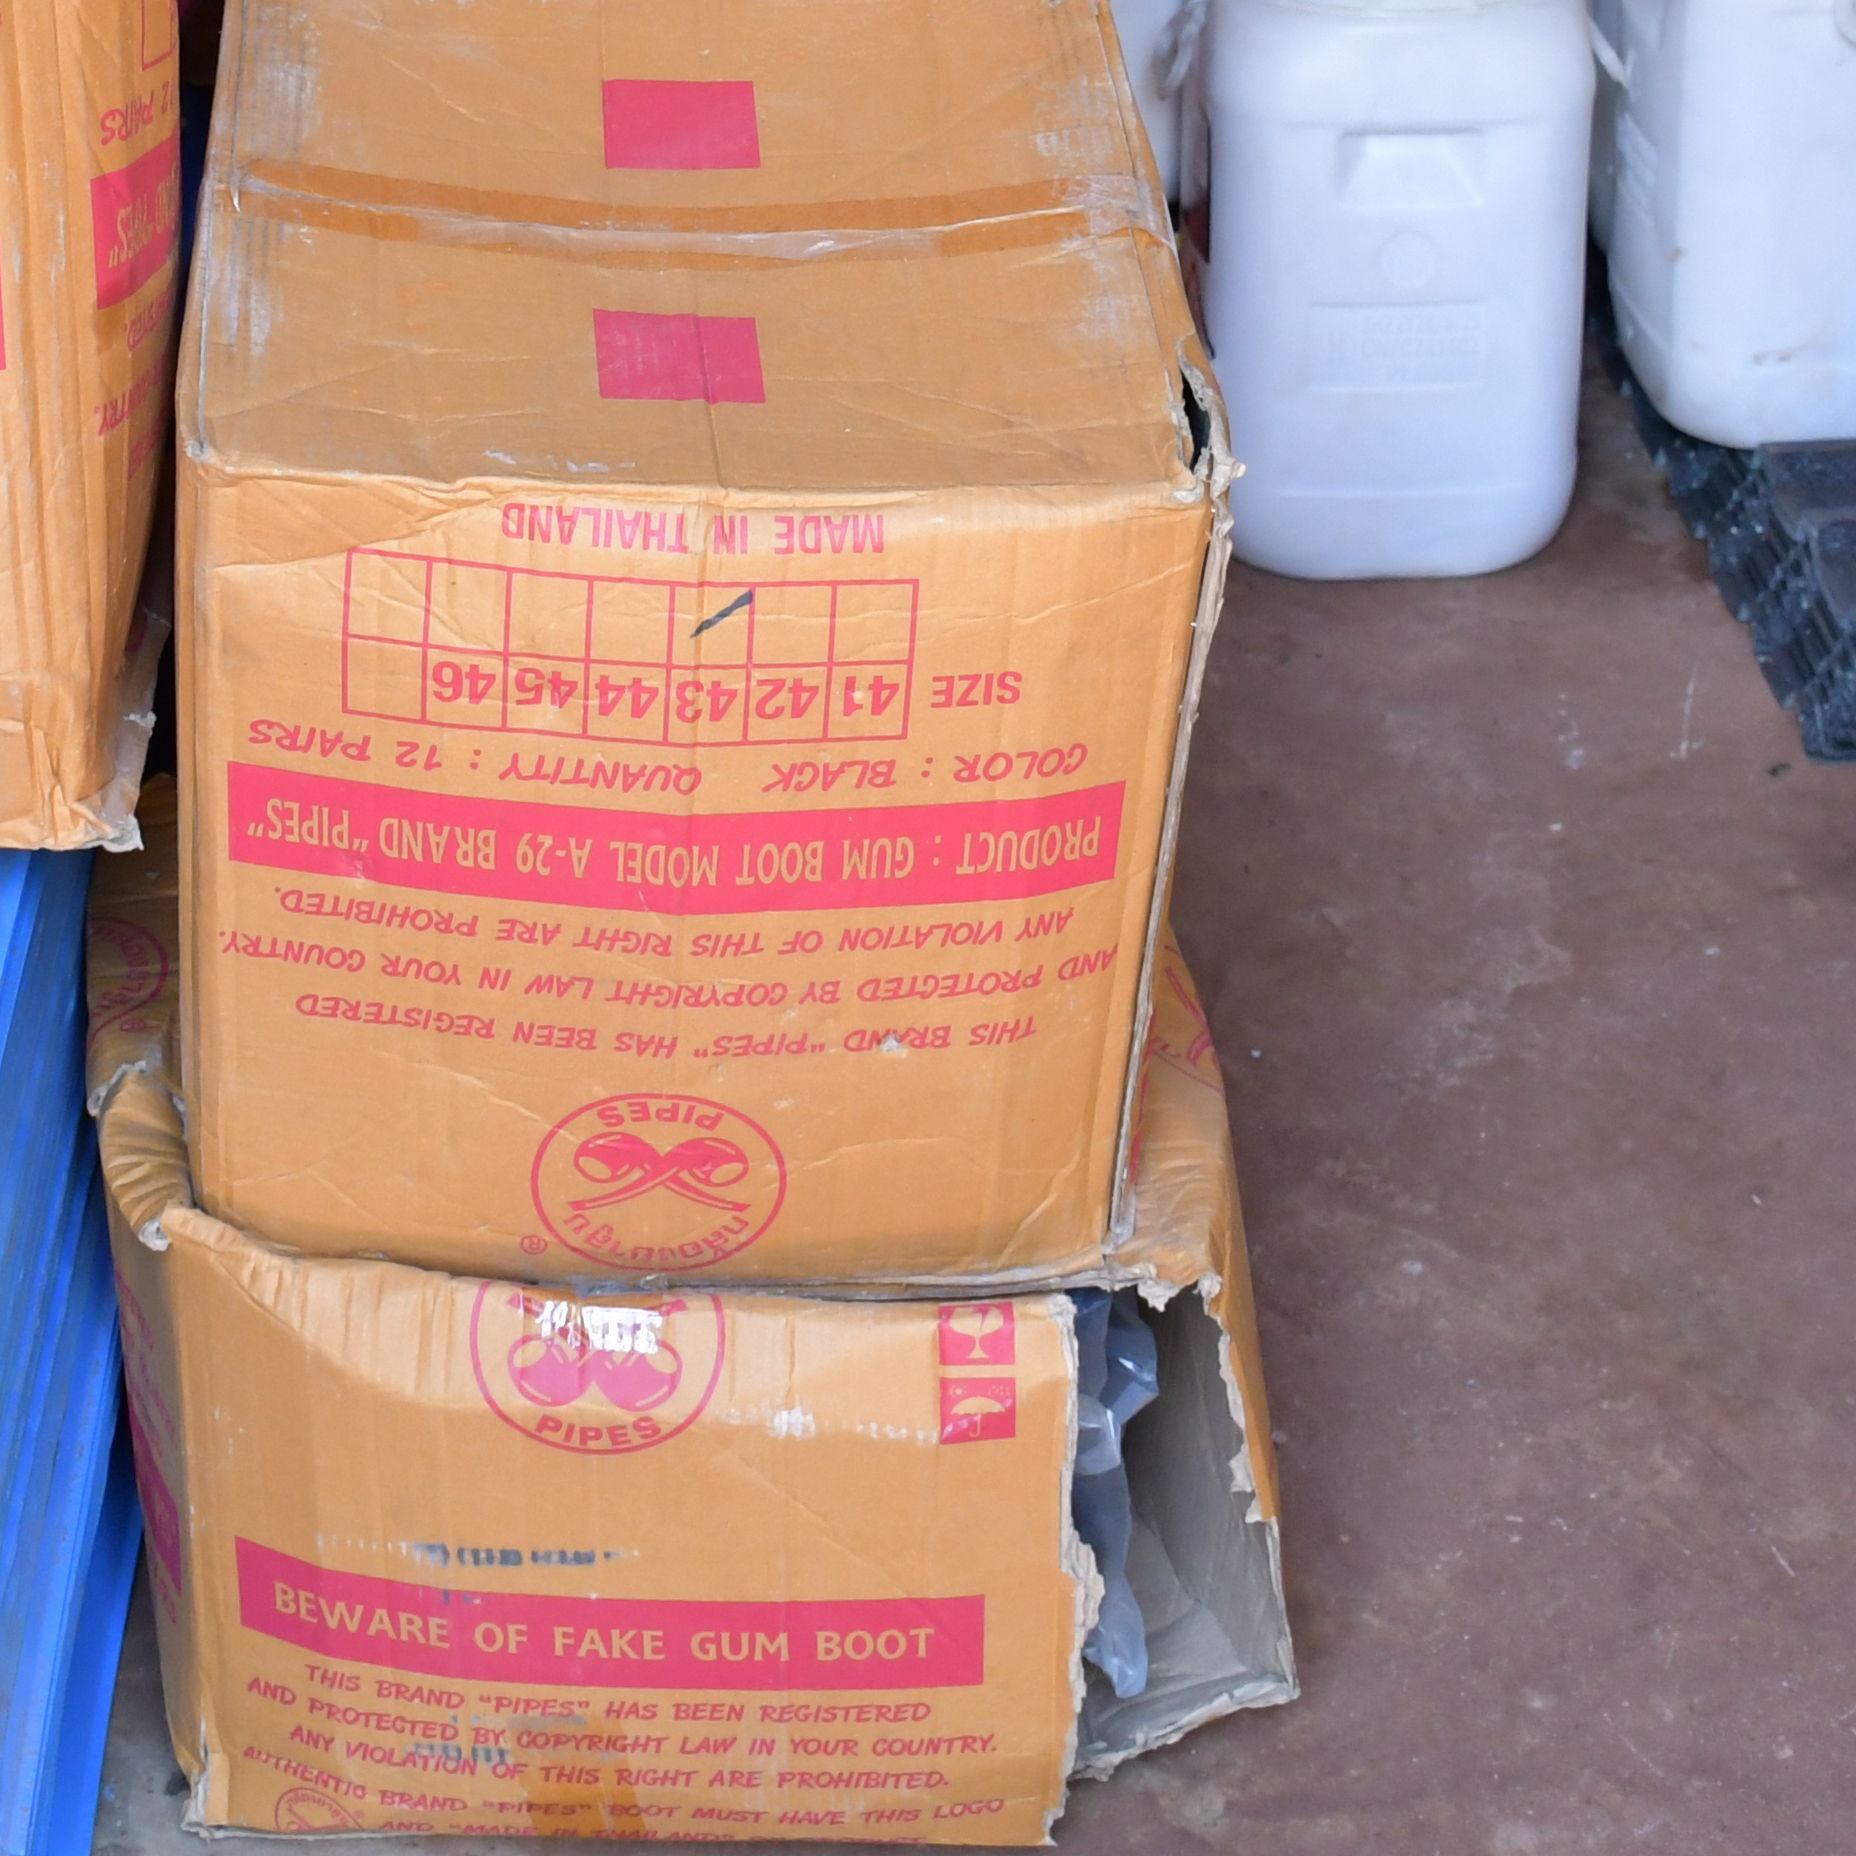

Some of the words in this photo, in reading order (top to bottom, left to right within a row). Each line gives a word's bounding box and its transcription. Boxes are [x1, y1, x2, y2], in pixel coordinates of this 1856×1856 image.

[501, 501, 690, 552] THAILAND
[712, 514, 750, 553] IN
[773, 513, 886, 555] MADE
[430, 660, 498, 706] 46
[514, 666, 579, 710] 45
[594, 674, 661, 720] 44
[674, 679, 739, 724] 43
[754, 677, 821, 721] 42
[842, 675, 901, 718] 41
[931, 670, 1024, 710] SIZE
[248, 718, 372, 763] PAIRS
[395, 739, 443, 773] 12
[498, 752, 704, 797] QUANTITY
[762, 759, 897, 794] BLACK
[953, 743, 1089, 785] COLOR
[379, 817, 496, 871] BRAND
[516, 833, 593, 879] A-29
[610, 840, 720, 889] MODEL
[736, 840, 824, 886] BOOT
[842, 836, 916, 881] GUM
[956, 816, 1102, 876] PRODUCT
[592, 1097, 730, 1137] PIPES
[534, 1414, 662, 1448] PIPES
[275, 1581, 447, 1648] BEWARE
[474, 1622, 526, 1653] OF
[554, 1626, 661, 1661] FAKE
[691, 1631, 790, 1662] GUM
[816, 1627, 934, 1662] BOOT
[308, 1664, 361, 1693] THIS
[376, 1679, 466, 1712] BRAND
[604, 1701, 659, 1722] HAS
[673, 1702, 746, 1723] BEEN
[759, 1702, 933, 1724] REGISTERED
